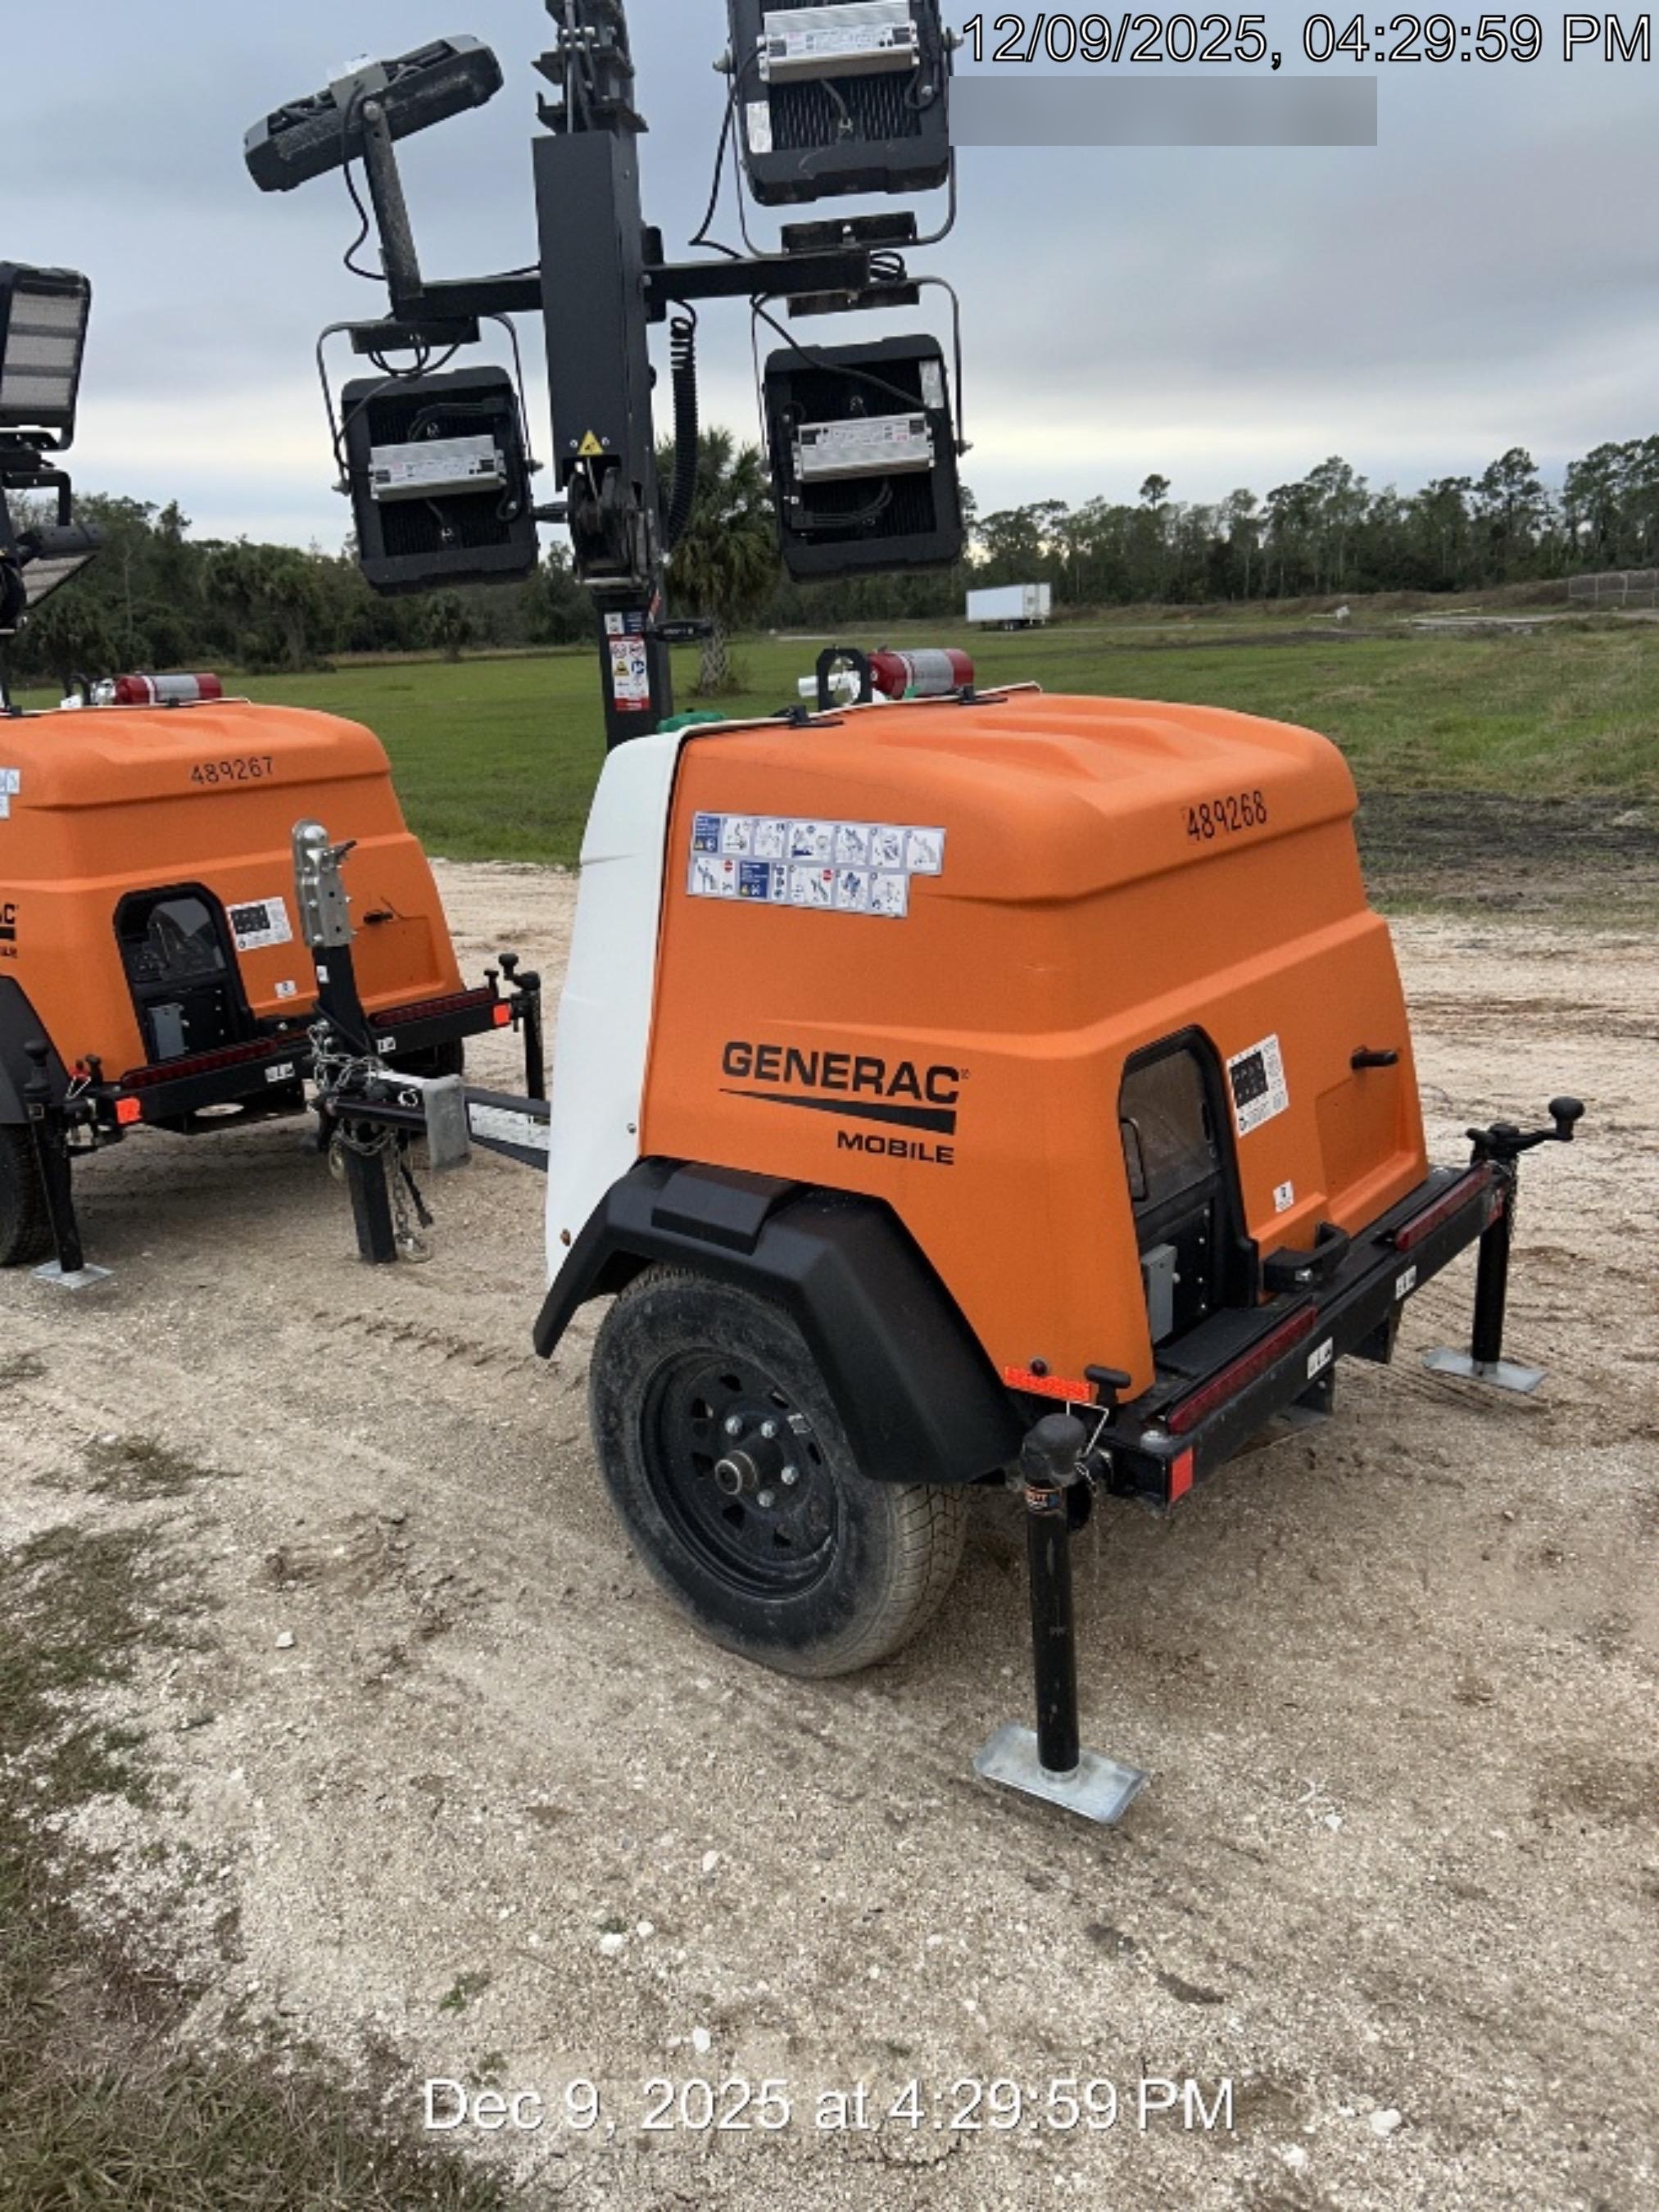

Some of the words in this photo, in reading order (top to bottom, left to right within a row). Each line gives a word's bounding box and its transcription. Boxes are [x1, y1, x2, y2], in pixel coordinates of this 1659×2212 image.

[191, 756, 272, 785] 489267
[1187, 790, 1267, 841] 489268
[722, 1040, 959, 1104] GENERAC
[837, 1130, 955, 1165] MOBILE
